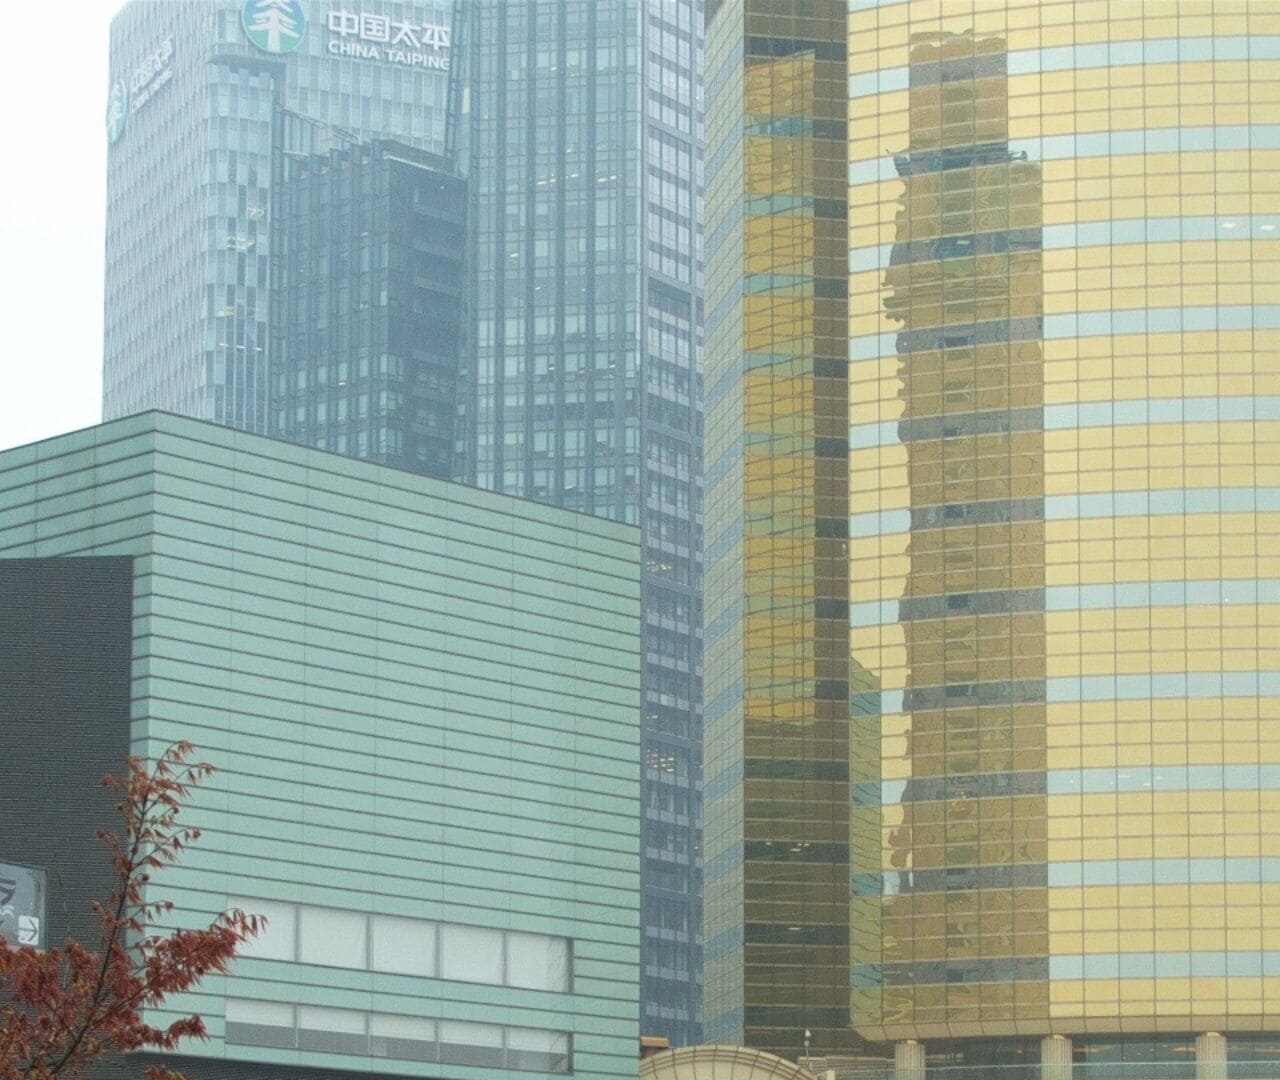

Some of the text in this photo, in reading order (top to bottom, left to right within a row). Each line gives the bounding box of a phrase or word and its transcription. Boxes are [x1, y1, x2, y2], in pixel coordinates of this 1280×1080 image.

[327, 9, 450, 50] 中国太平
[327, 40, 450, 70] CHINA TAIPING
